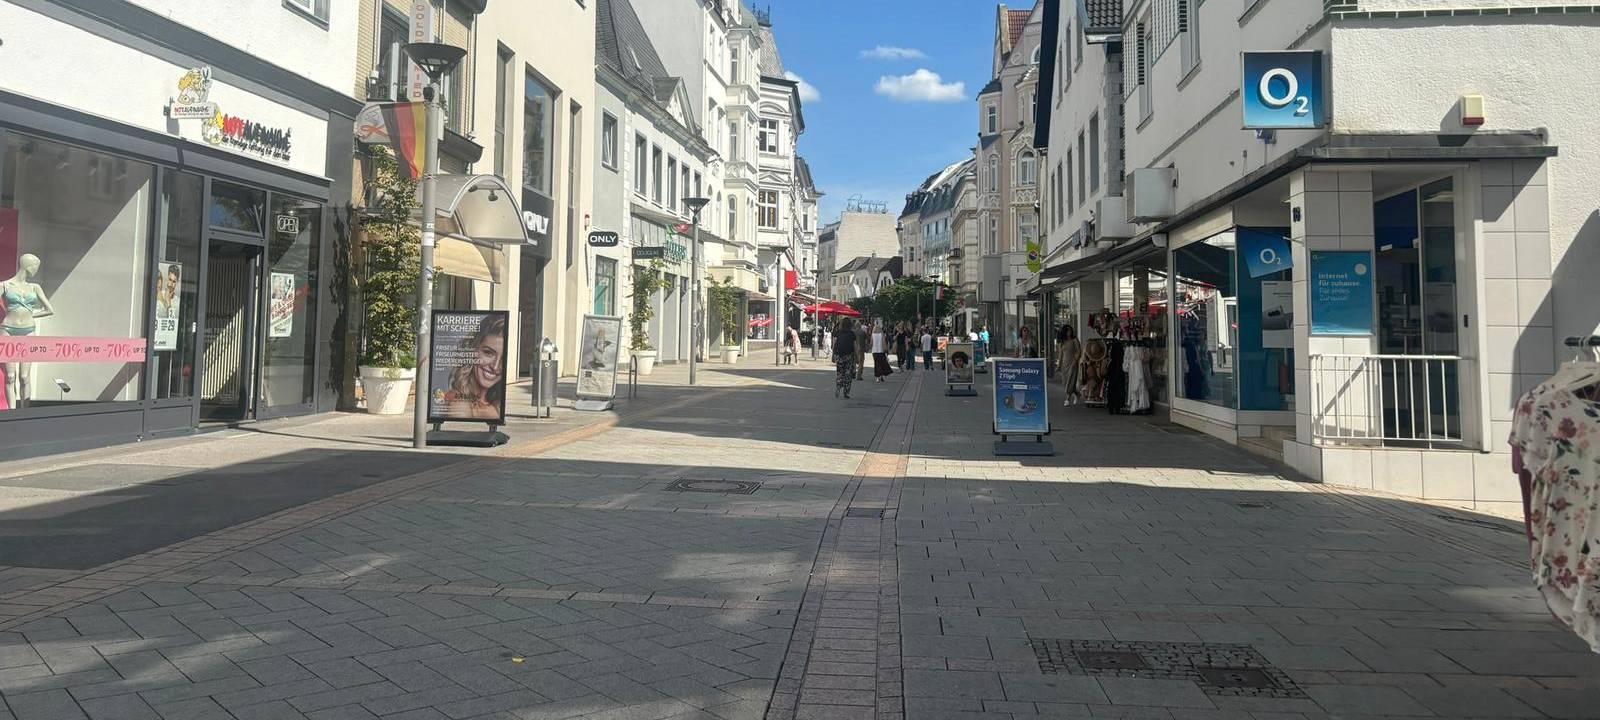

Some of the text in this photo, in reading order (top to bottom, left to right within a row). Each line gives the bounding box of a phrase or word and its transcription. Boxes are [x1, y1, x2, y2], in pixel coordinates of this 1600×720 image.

[590, 235, 617, 243] ONLY
[437, 315, 480, 325] KARRIERE
[999, 367, 1021, 375] Samsung
